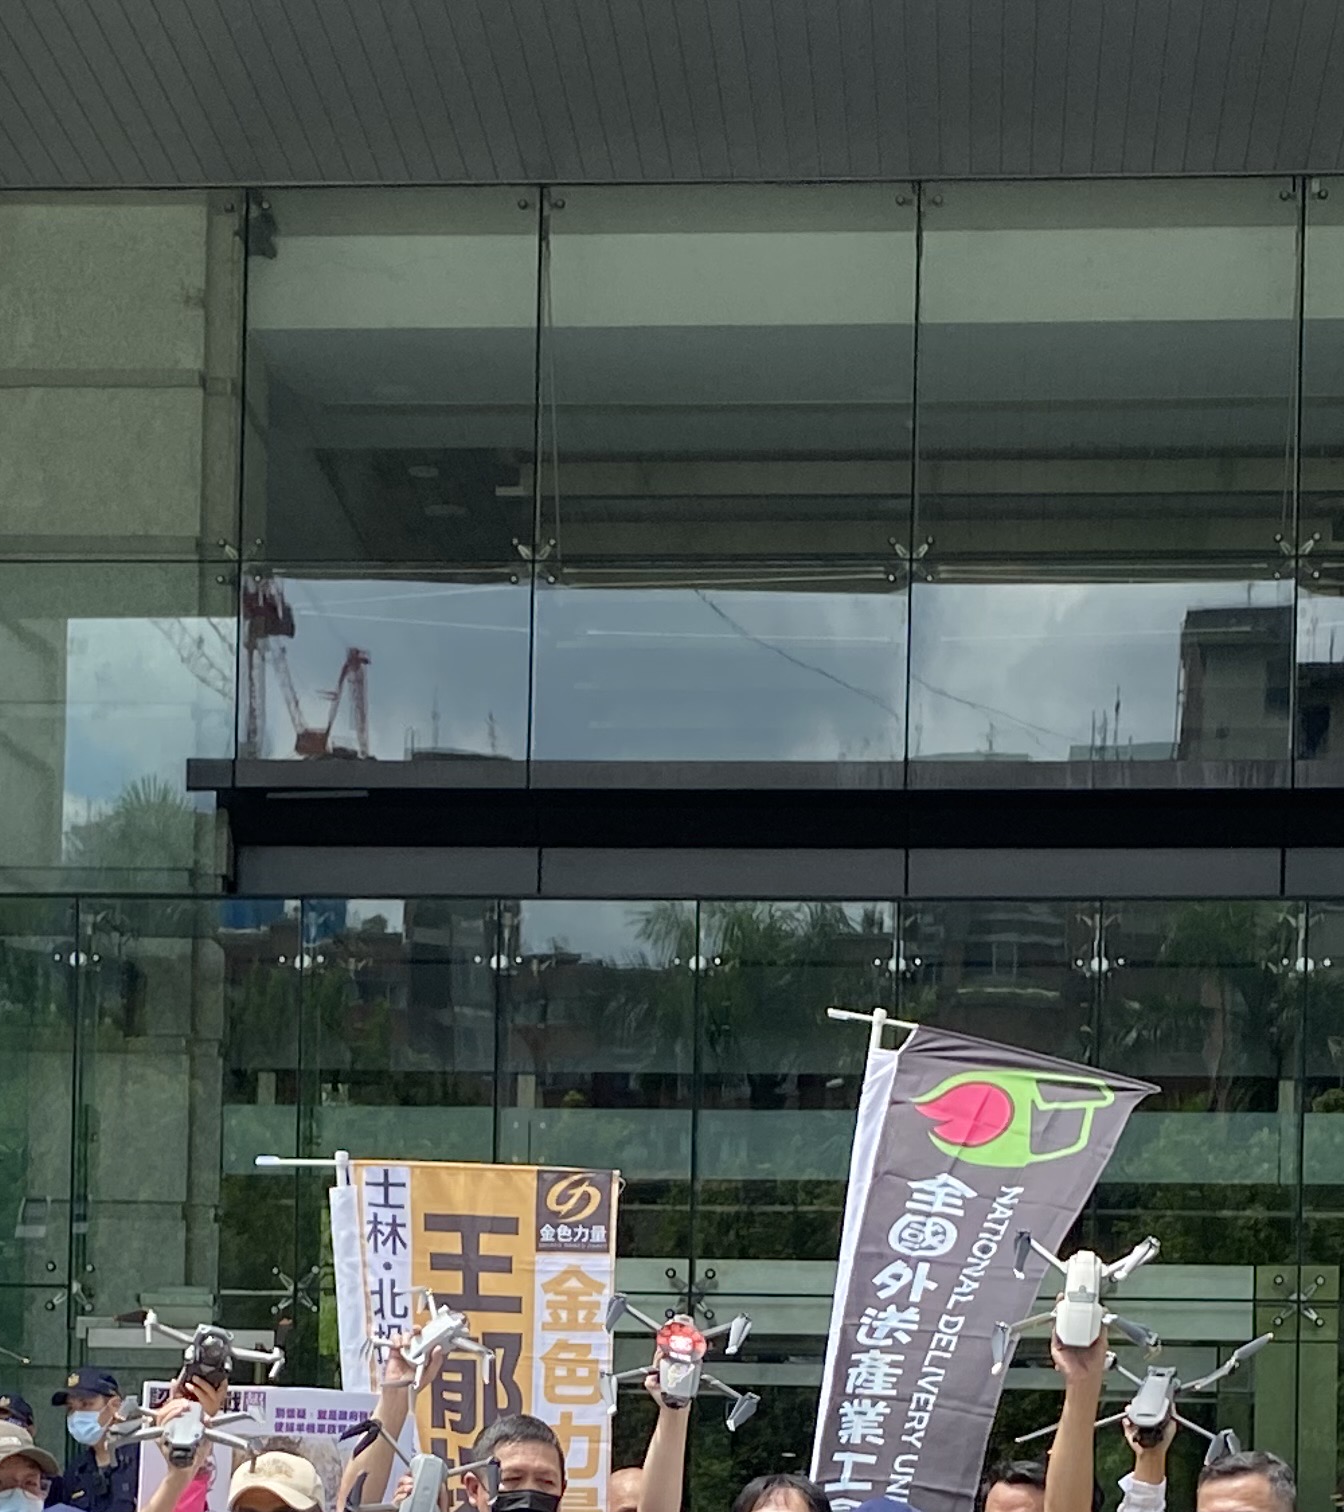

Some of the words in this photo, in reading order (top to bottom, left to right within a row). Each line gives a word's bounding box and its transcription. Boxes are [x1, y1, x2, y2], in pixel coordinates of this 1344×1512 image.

[538, 1223, 608, 1243] 金色力量
[945, 1185, 1025, 1310] NATIONAL
[900, 1313, 966, 1449] DELIVERY
